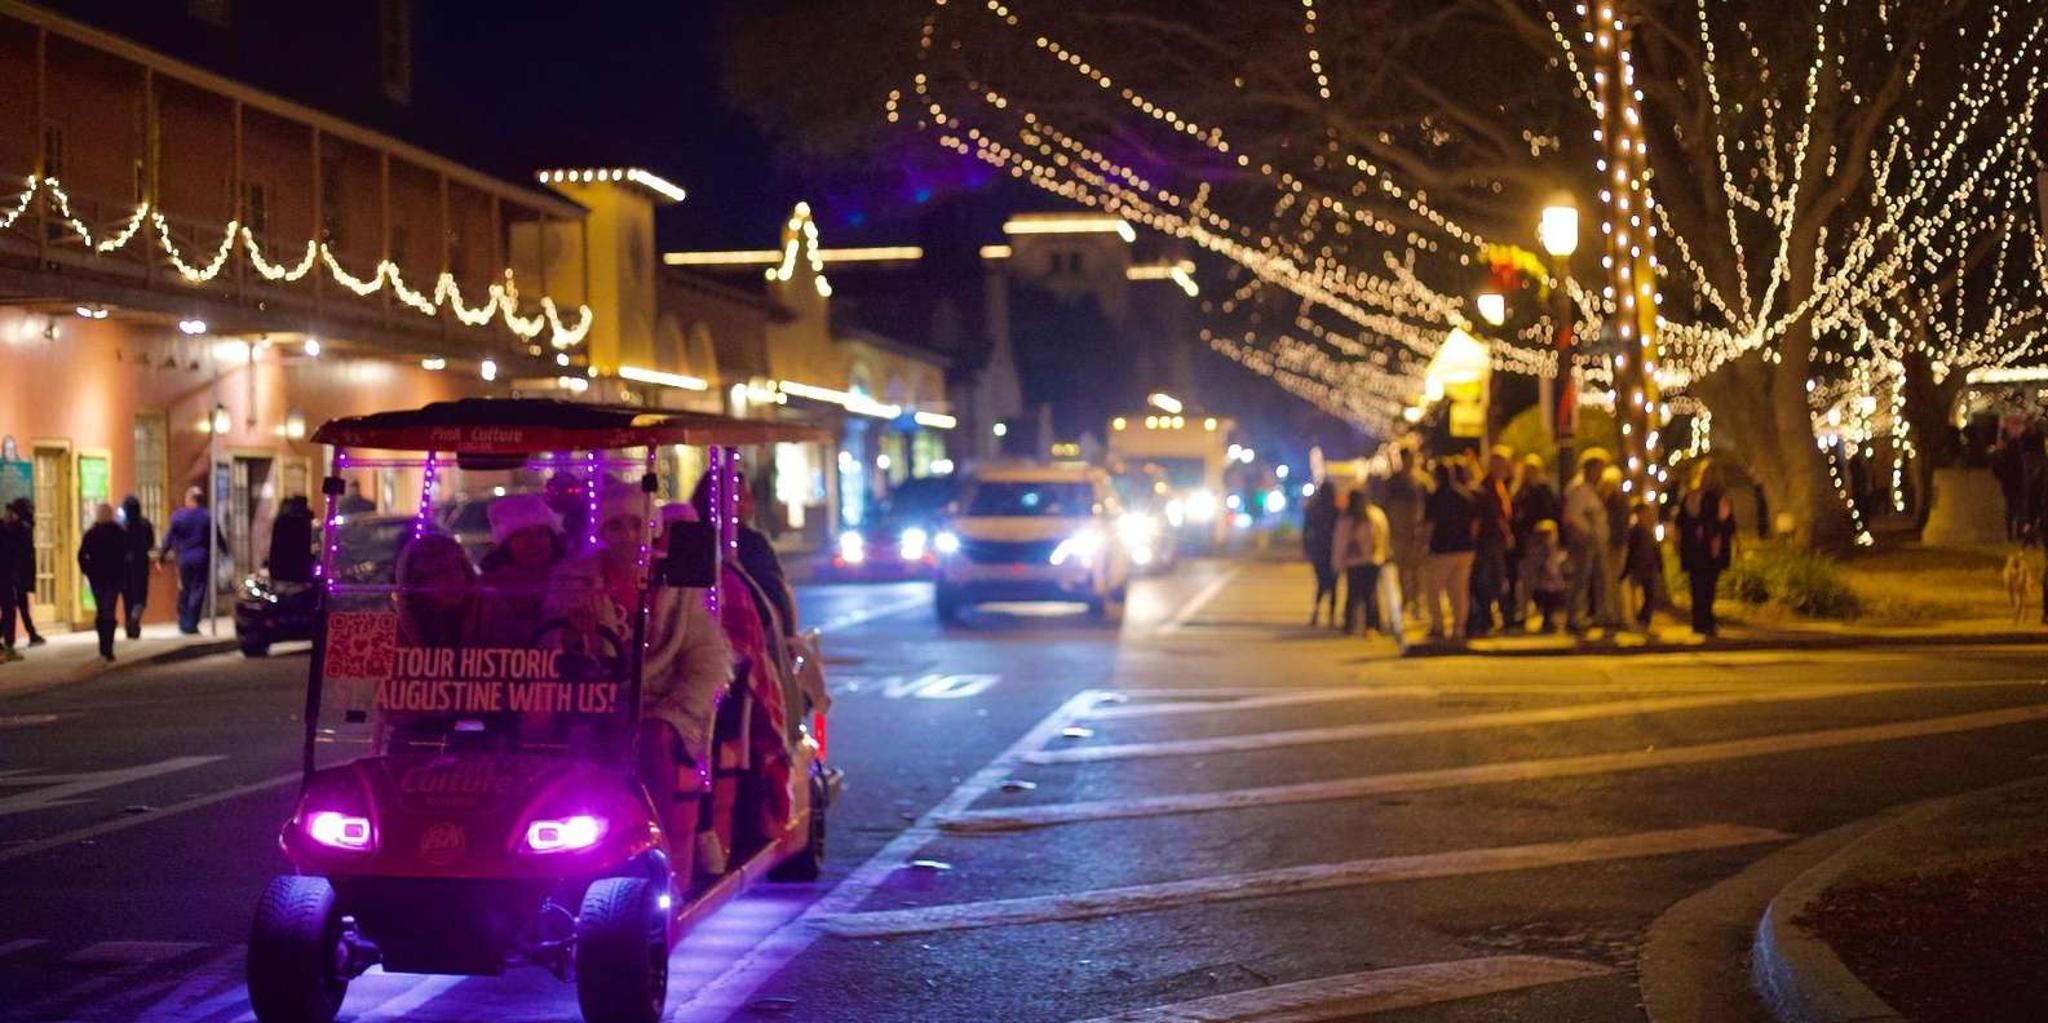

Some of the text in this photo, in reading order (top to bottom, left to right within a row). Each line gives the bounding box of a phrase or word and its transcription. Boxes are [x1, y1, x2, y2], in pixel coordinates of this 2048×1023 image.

[471, 426, 523, 444] Culture
[395, 647, 562, 680] TOUR HISTORIC
[374, 679, 503, 712] AUGUSTINE
[508, 681, 573, 713] WITH
[577, 682, 619, 714] US!
